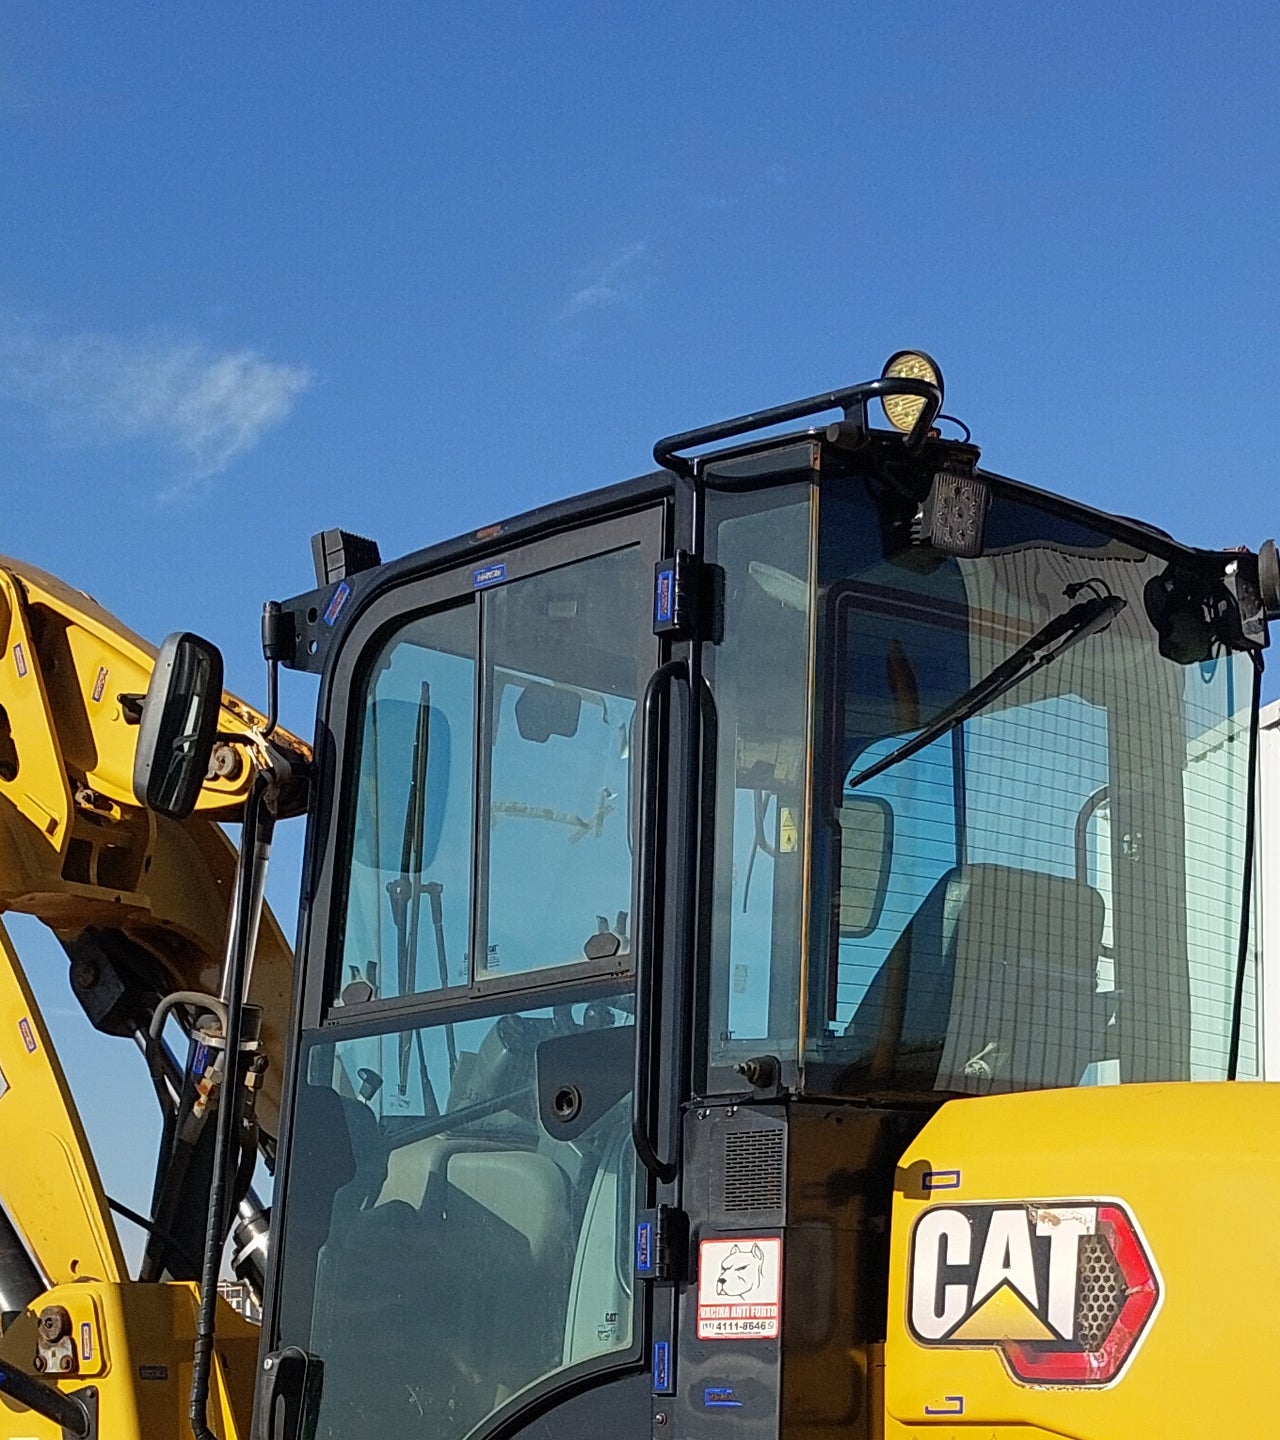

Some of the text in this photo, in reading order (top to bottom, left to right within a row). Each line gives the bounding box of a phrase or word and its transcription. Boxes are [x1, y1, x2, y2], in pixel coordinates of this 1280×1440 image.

[911, 1206, 1098, 1341] CAT
[700, 1305, 777, 1319] VACINA ANTI FURTO
